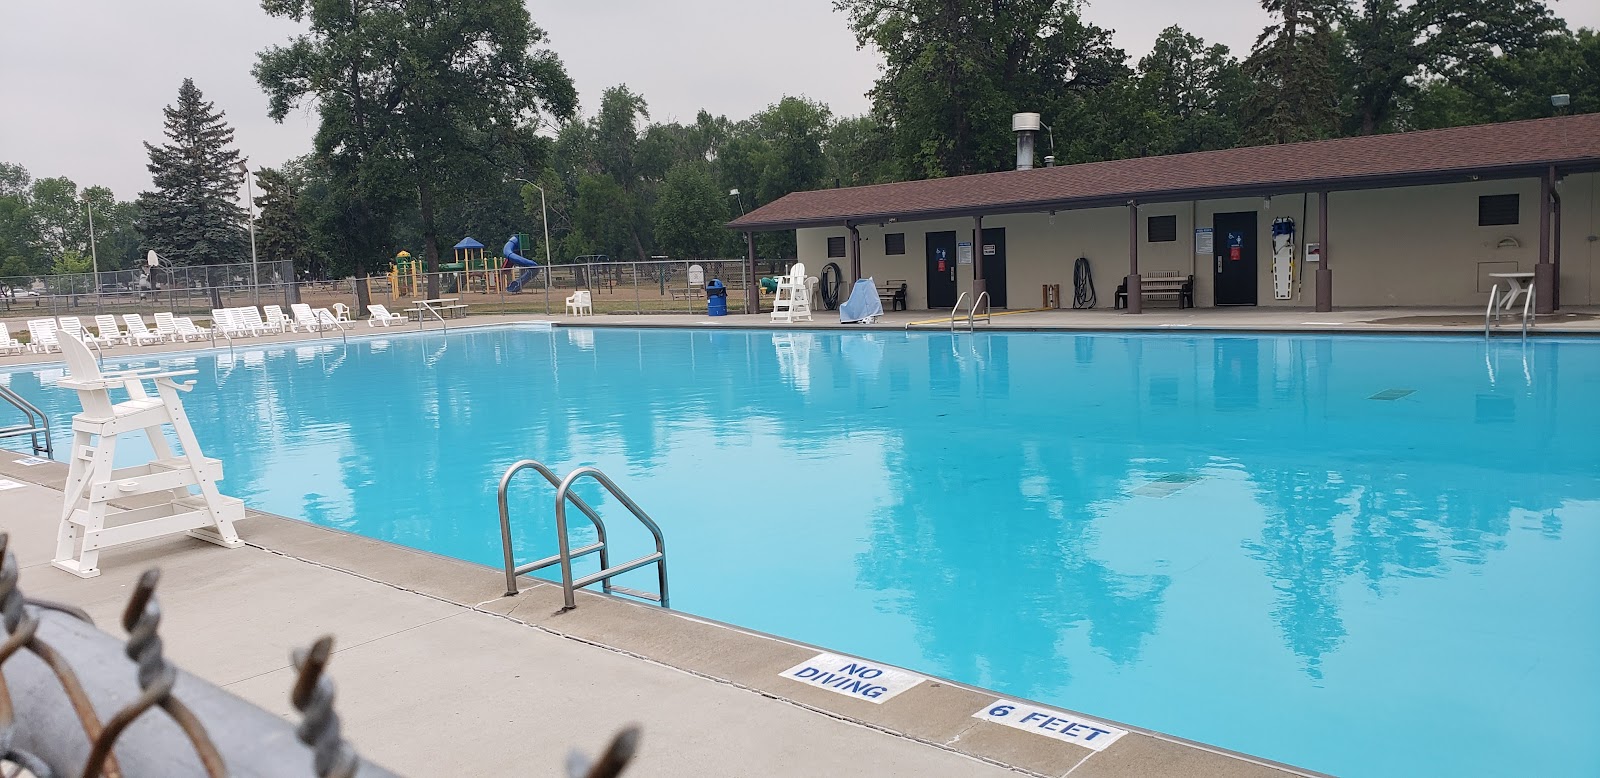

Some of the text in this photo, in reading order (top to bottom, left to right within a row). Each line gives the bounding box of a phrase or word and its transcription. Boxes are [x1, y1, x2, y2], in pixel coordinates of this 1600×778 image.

[794, 666, 888, 699] DIVING
[839, 663, 883, 680] NO
[988, 705, 1110, 741] 6 FEET
